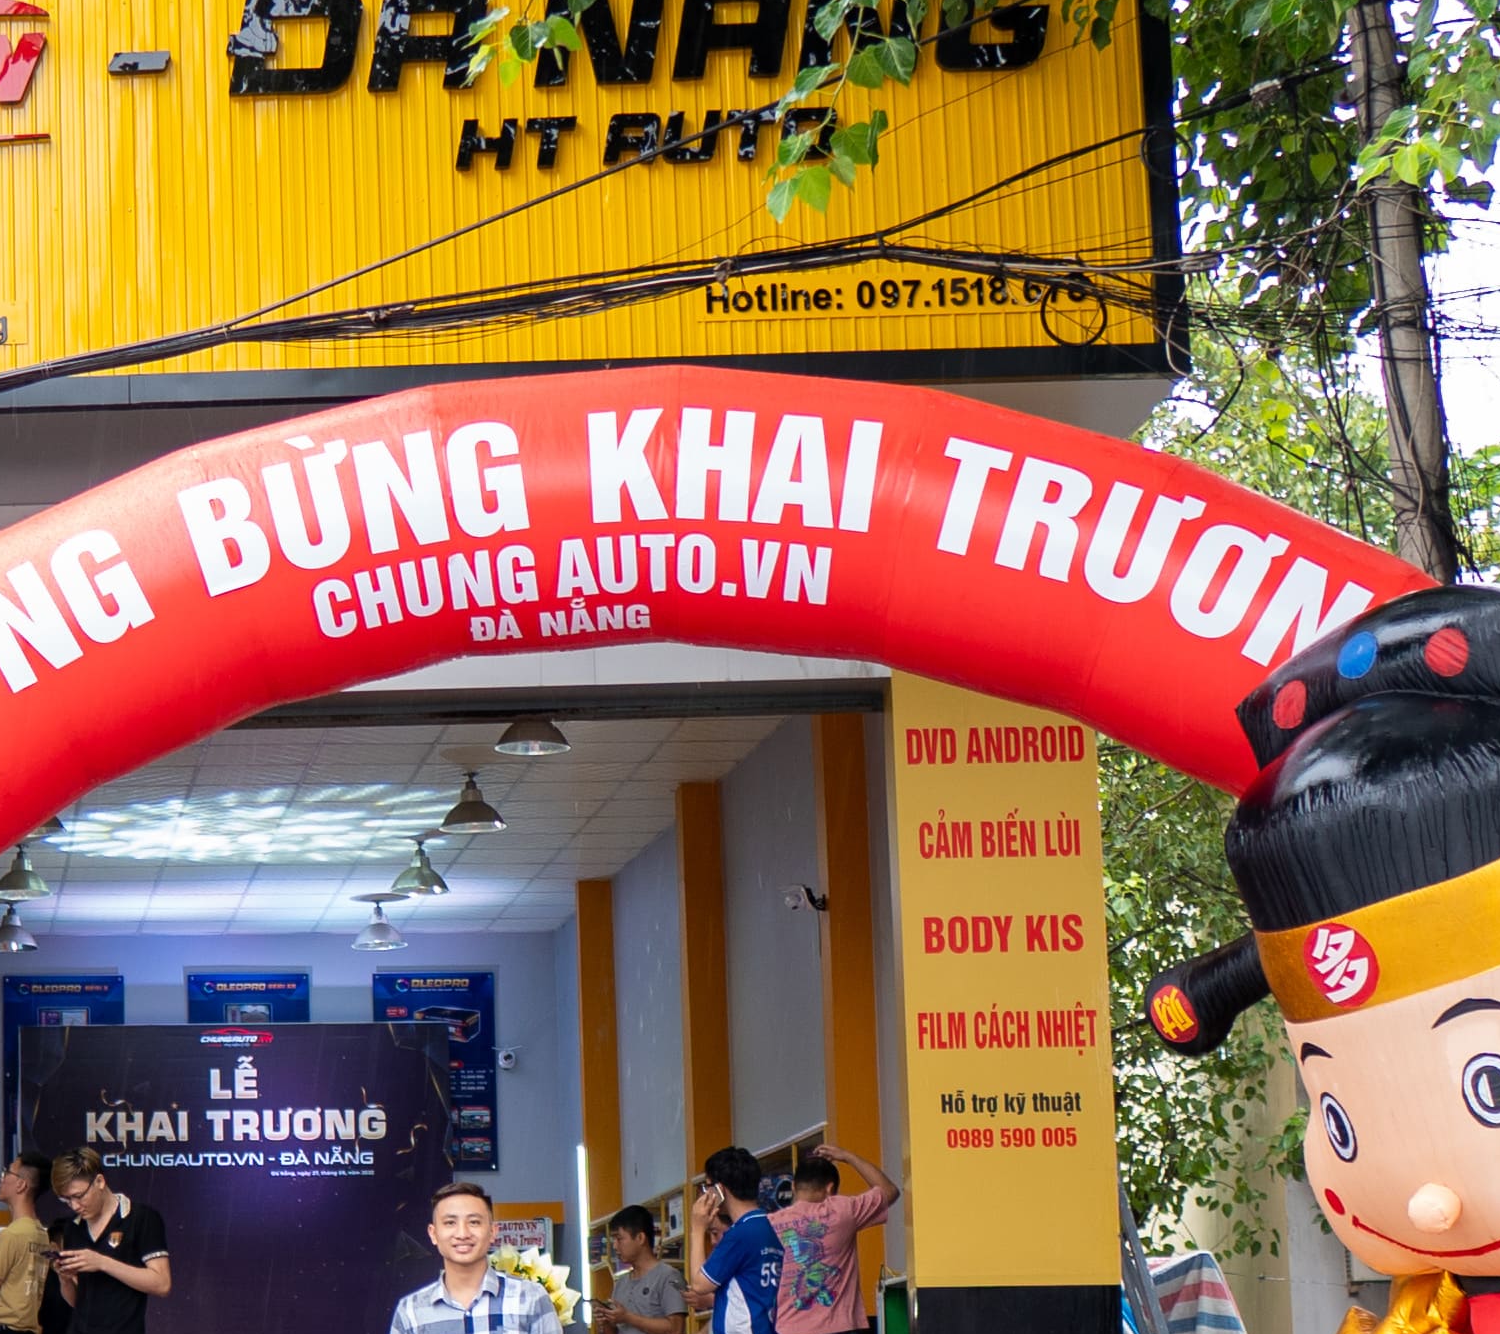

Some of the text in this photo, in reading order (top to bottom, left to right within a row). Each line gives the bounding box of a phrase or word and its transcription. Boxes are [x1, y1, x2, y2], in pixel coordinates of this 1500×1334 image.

[455, 105, 838, 170] HT AUTO
[706, 283, 843, 315] Hotline:
[178, 421, 530, 597] BỪNG
[588, 408, 883, 532] KHAI
[936, 437, 1375, 666] TRƯƠN
[312, 533, 832, 638] CHUNG AUTO.VN
[470, 598, 650, 641] ĐÀ NẴNG
[906, 725, 1085, 765] DVD ANDROID
[919, 808, 1081, 859] CẢM BIẾN LÙI
[923, 914, 1084, 954] BODY KIS
[1312, 928, 1368, 1003] 多
[917, 1001, 1096, 1056] FILM CÁCH NHIỆT
[210, 1056, 258, 1099] LỄ
[86, 1107, 387, 1142] KHAI TRƯƠNG
[941, 1090, 1081, 1117] Hỗ trợ kỹ thuật
[103, 1152, 263, 1167] CHUNGAUTO.VN
[279, 1149, 310, 1166] ĐÀ
[314, 1146, 374, 1165] NẴNG
[947, 1127, 1077, 1148] 0989 590 005
